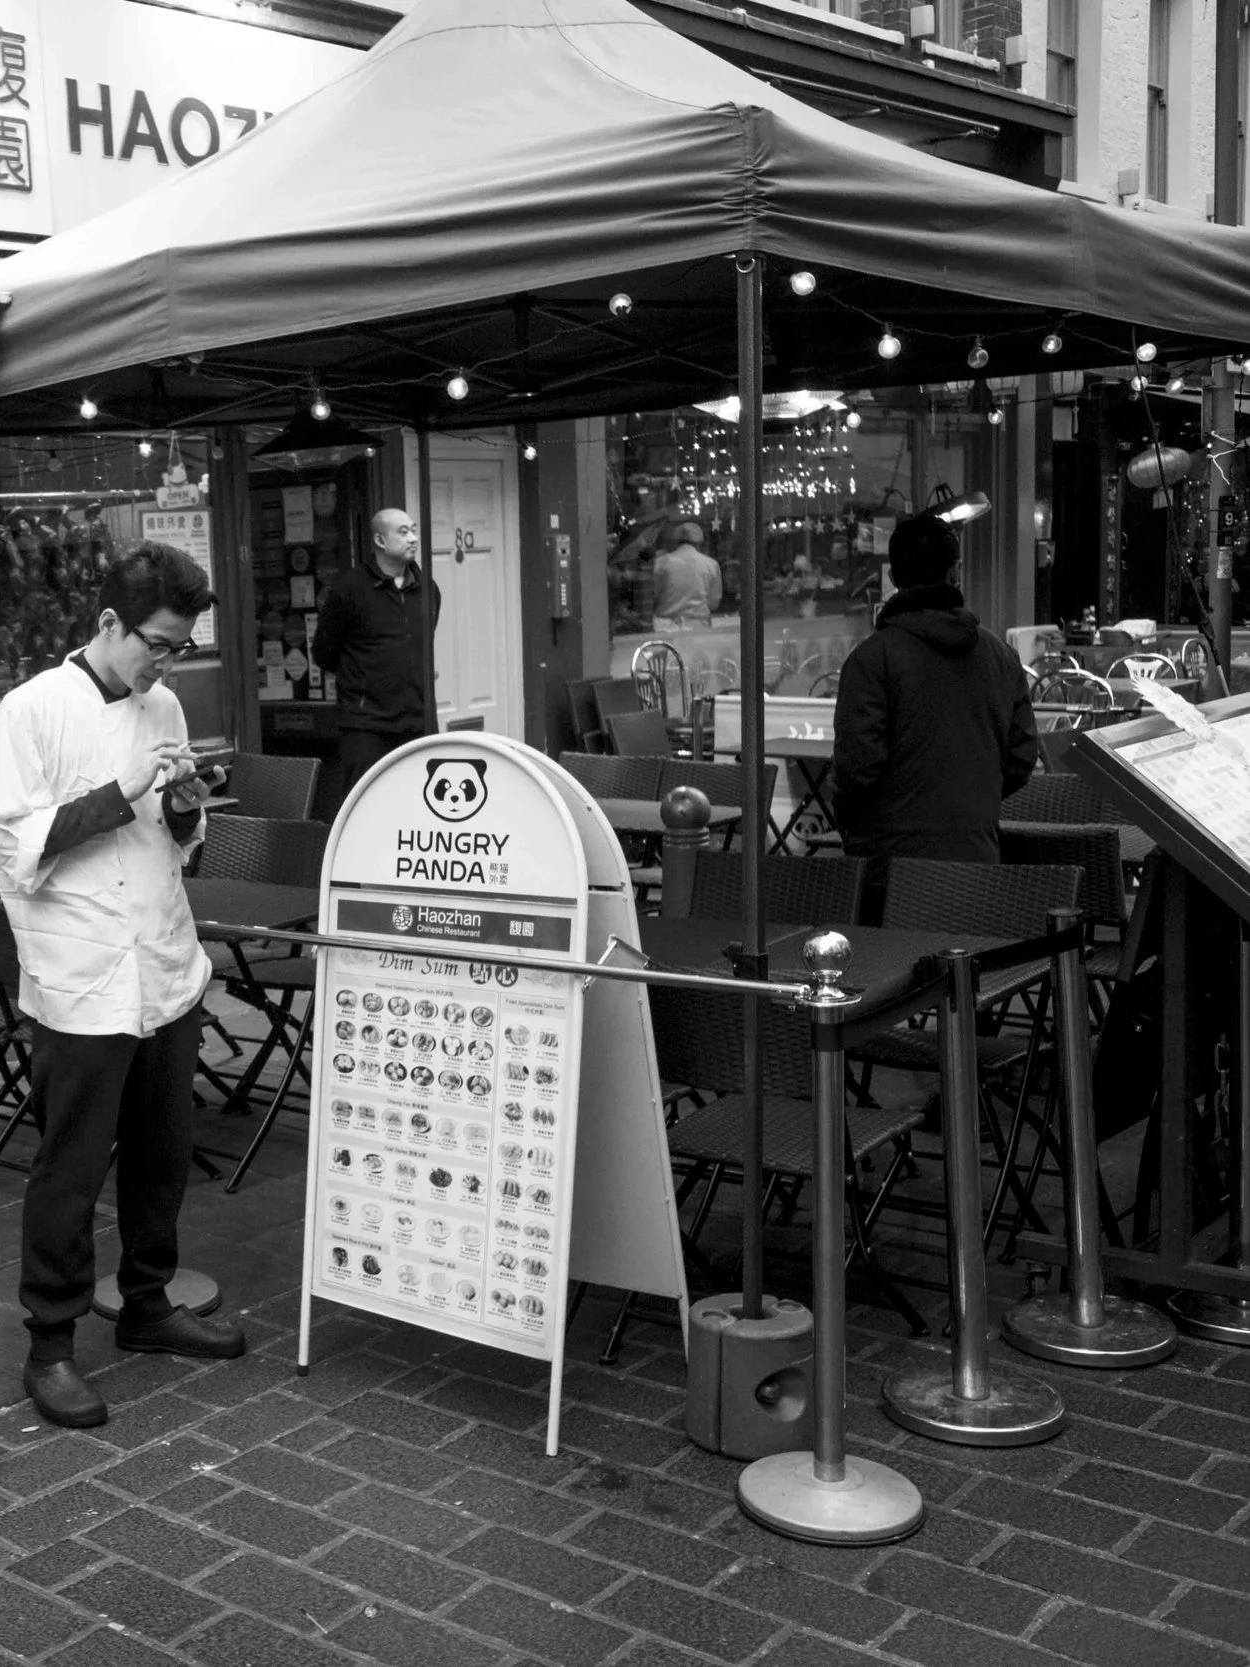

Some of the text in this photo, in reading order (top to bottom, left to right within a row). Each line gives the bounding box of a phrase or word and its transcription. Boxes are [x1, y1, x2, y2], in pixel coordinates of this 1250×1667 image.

[65, 77, 274, 168] HAO
[1225, 512, 1234, 526] 9
[455, 527, 474, 549] 8a
[397, 829, 510, 856] HUNGRY
[396, 857, 485, 884] PANDA
[417, 906, 481, 927] Haozhan
[416, 924, 481, 938] Chinese Restaurant
[378, 952, 459, 977] Dim Sum
